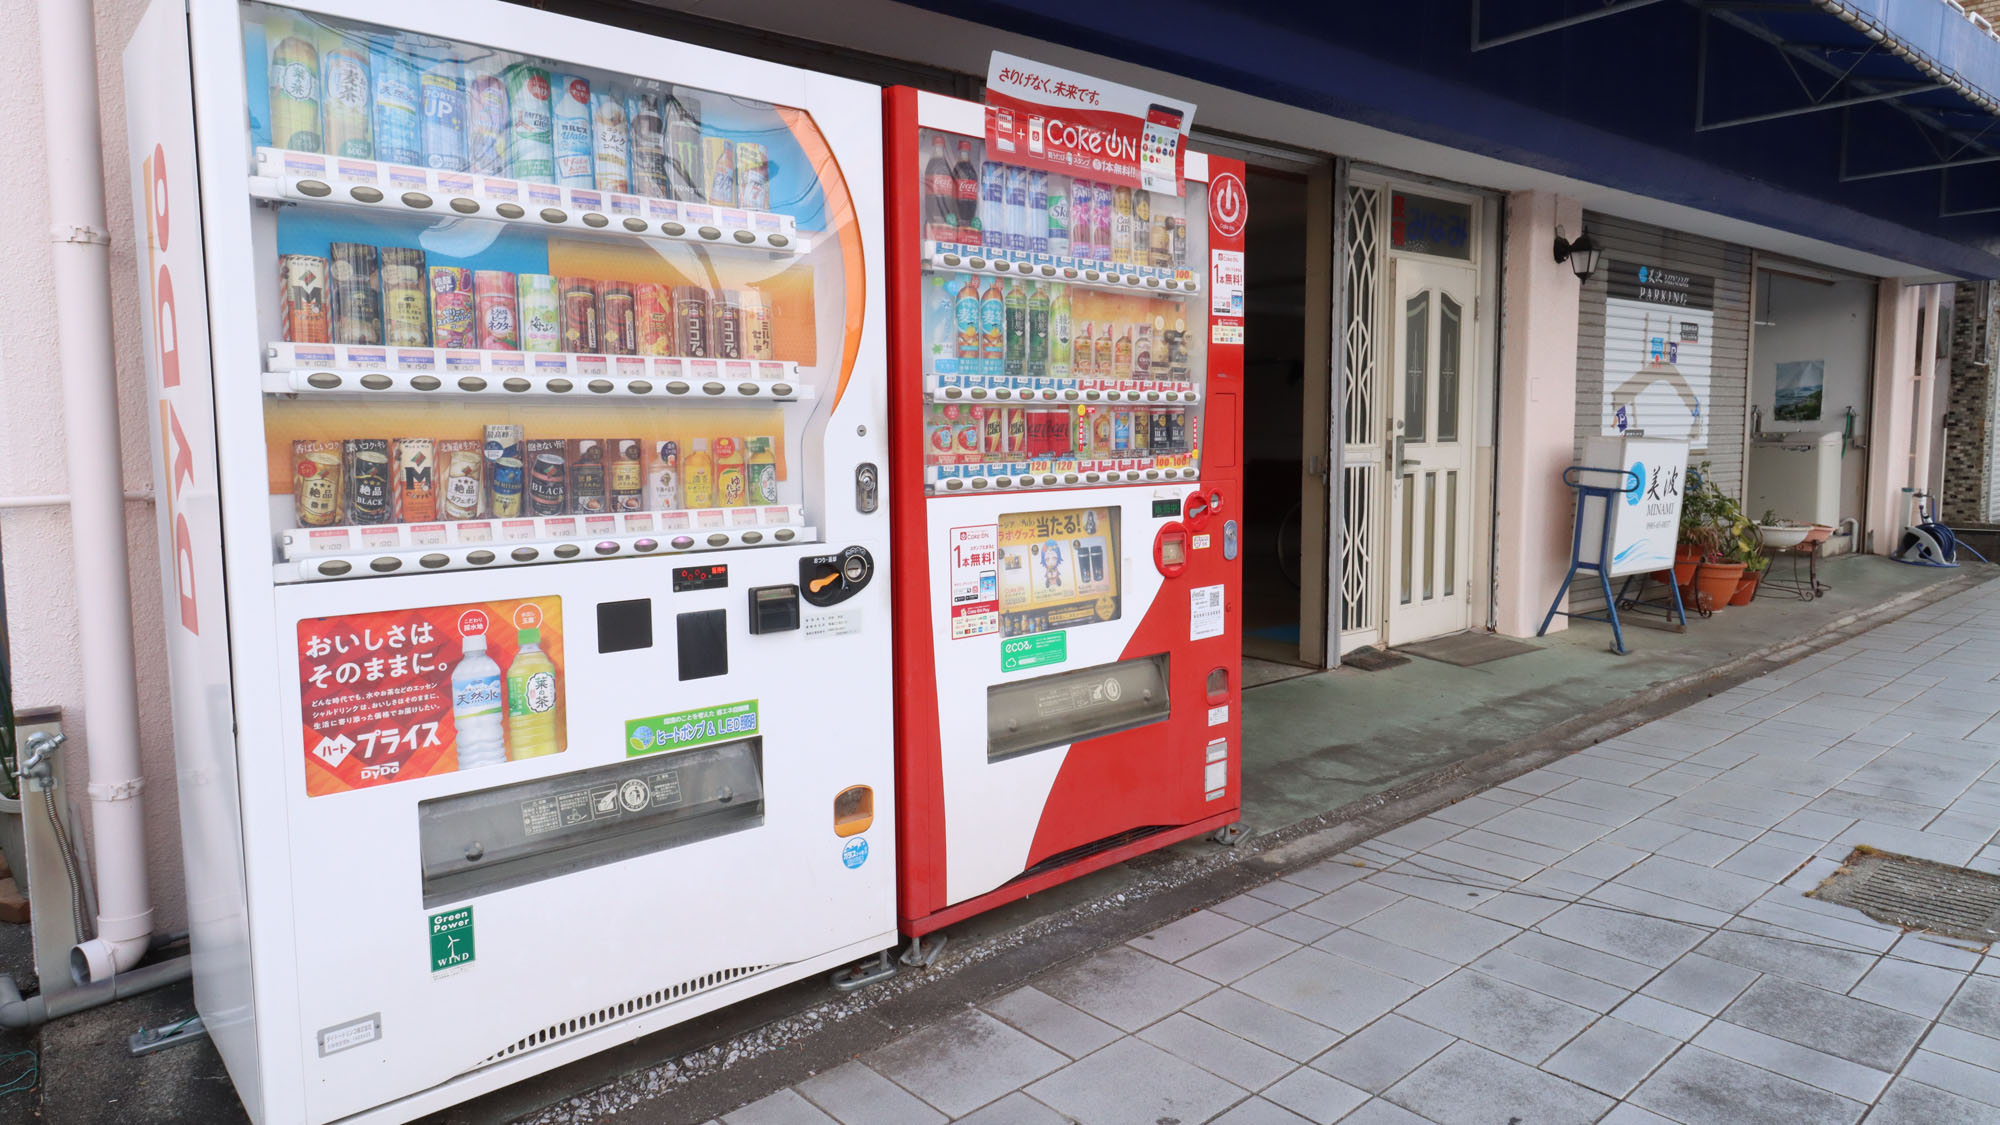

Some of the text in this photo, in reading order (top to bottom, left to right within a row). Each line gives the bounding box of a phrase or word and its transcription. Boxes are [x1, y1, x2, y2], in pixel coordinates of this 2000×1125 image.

[999, 67, 1100, 106] さりげなく、未来です。
[424, 97, 453, 119] UP
[600, 131, 627, 146] ミルク
[1176, 270, 1191, 279] 100
[1639, 286, 1688, 306] PARKING
[488, 320, 513, 331] ネクター
[688, 317, 701, 353] ココア
[723, 318, 736, 354] ココア
[761, 321, 770, 350] ミルク
[1031, 461, 1048, 471] 120
[1056, 461, 1073, 471] 120
[1155, 456, 1170, 467] 100
[1173, 455, 1187, 467] 100
[405, 466, 432, 490] M
[1646, 465, 1679, 501] 美波
[309, 486, 333, 500] 絶品
[359, 484, 383, 497] 絶品
[454, 483, 476, 495] 絶品
[531, 482, 565, 496] BLACK
[356, 496, 383, 506] BLACK
[1646, 502, 1675, 517] MINAMI
[1036, 514, 1082, 538] 当たる!
[954, 545, 996, 568] 1本無料!
[305, 622, 434, 659] おいしさは
[308, 652, 448, 689] そのままに。
[311, 682, 438, 707] どんな時代でも、水やお茶などのエッセン
[456, 690, 499, 706] 天然水
[535, 675, 549, 709] 葉の茶
[357, 721, 442, 759] プライス
[656, 720, 705, 745] ヒートポンプ
[322, 743, 348, 757] ハート
[361, 762, 400, 780] DyDo
[433, 918, 470, 934] Power
[434, 911, 468, 925] Green
[437, 952, 470, 967] WIND
